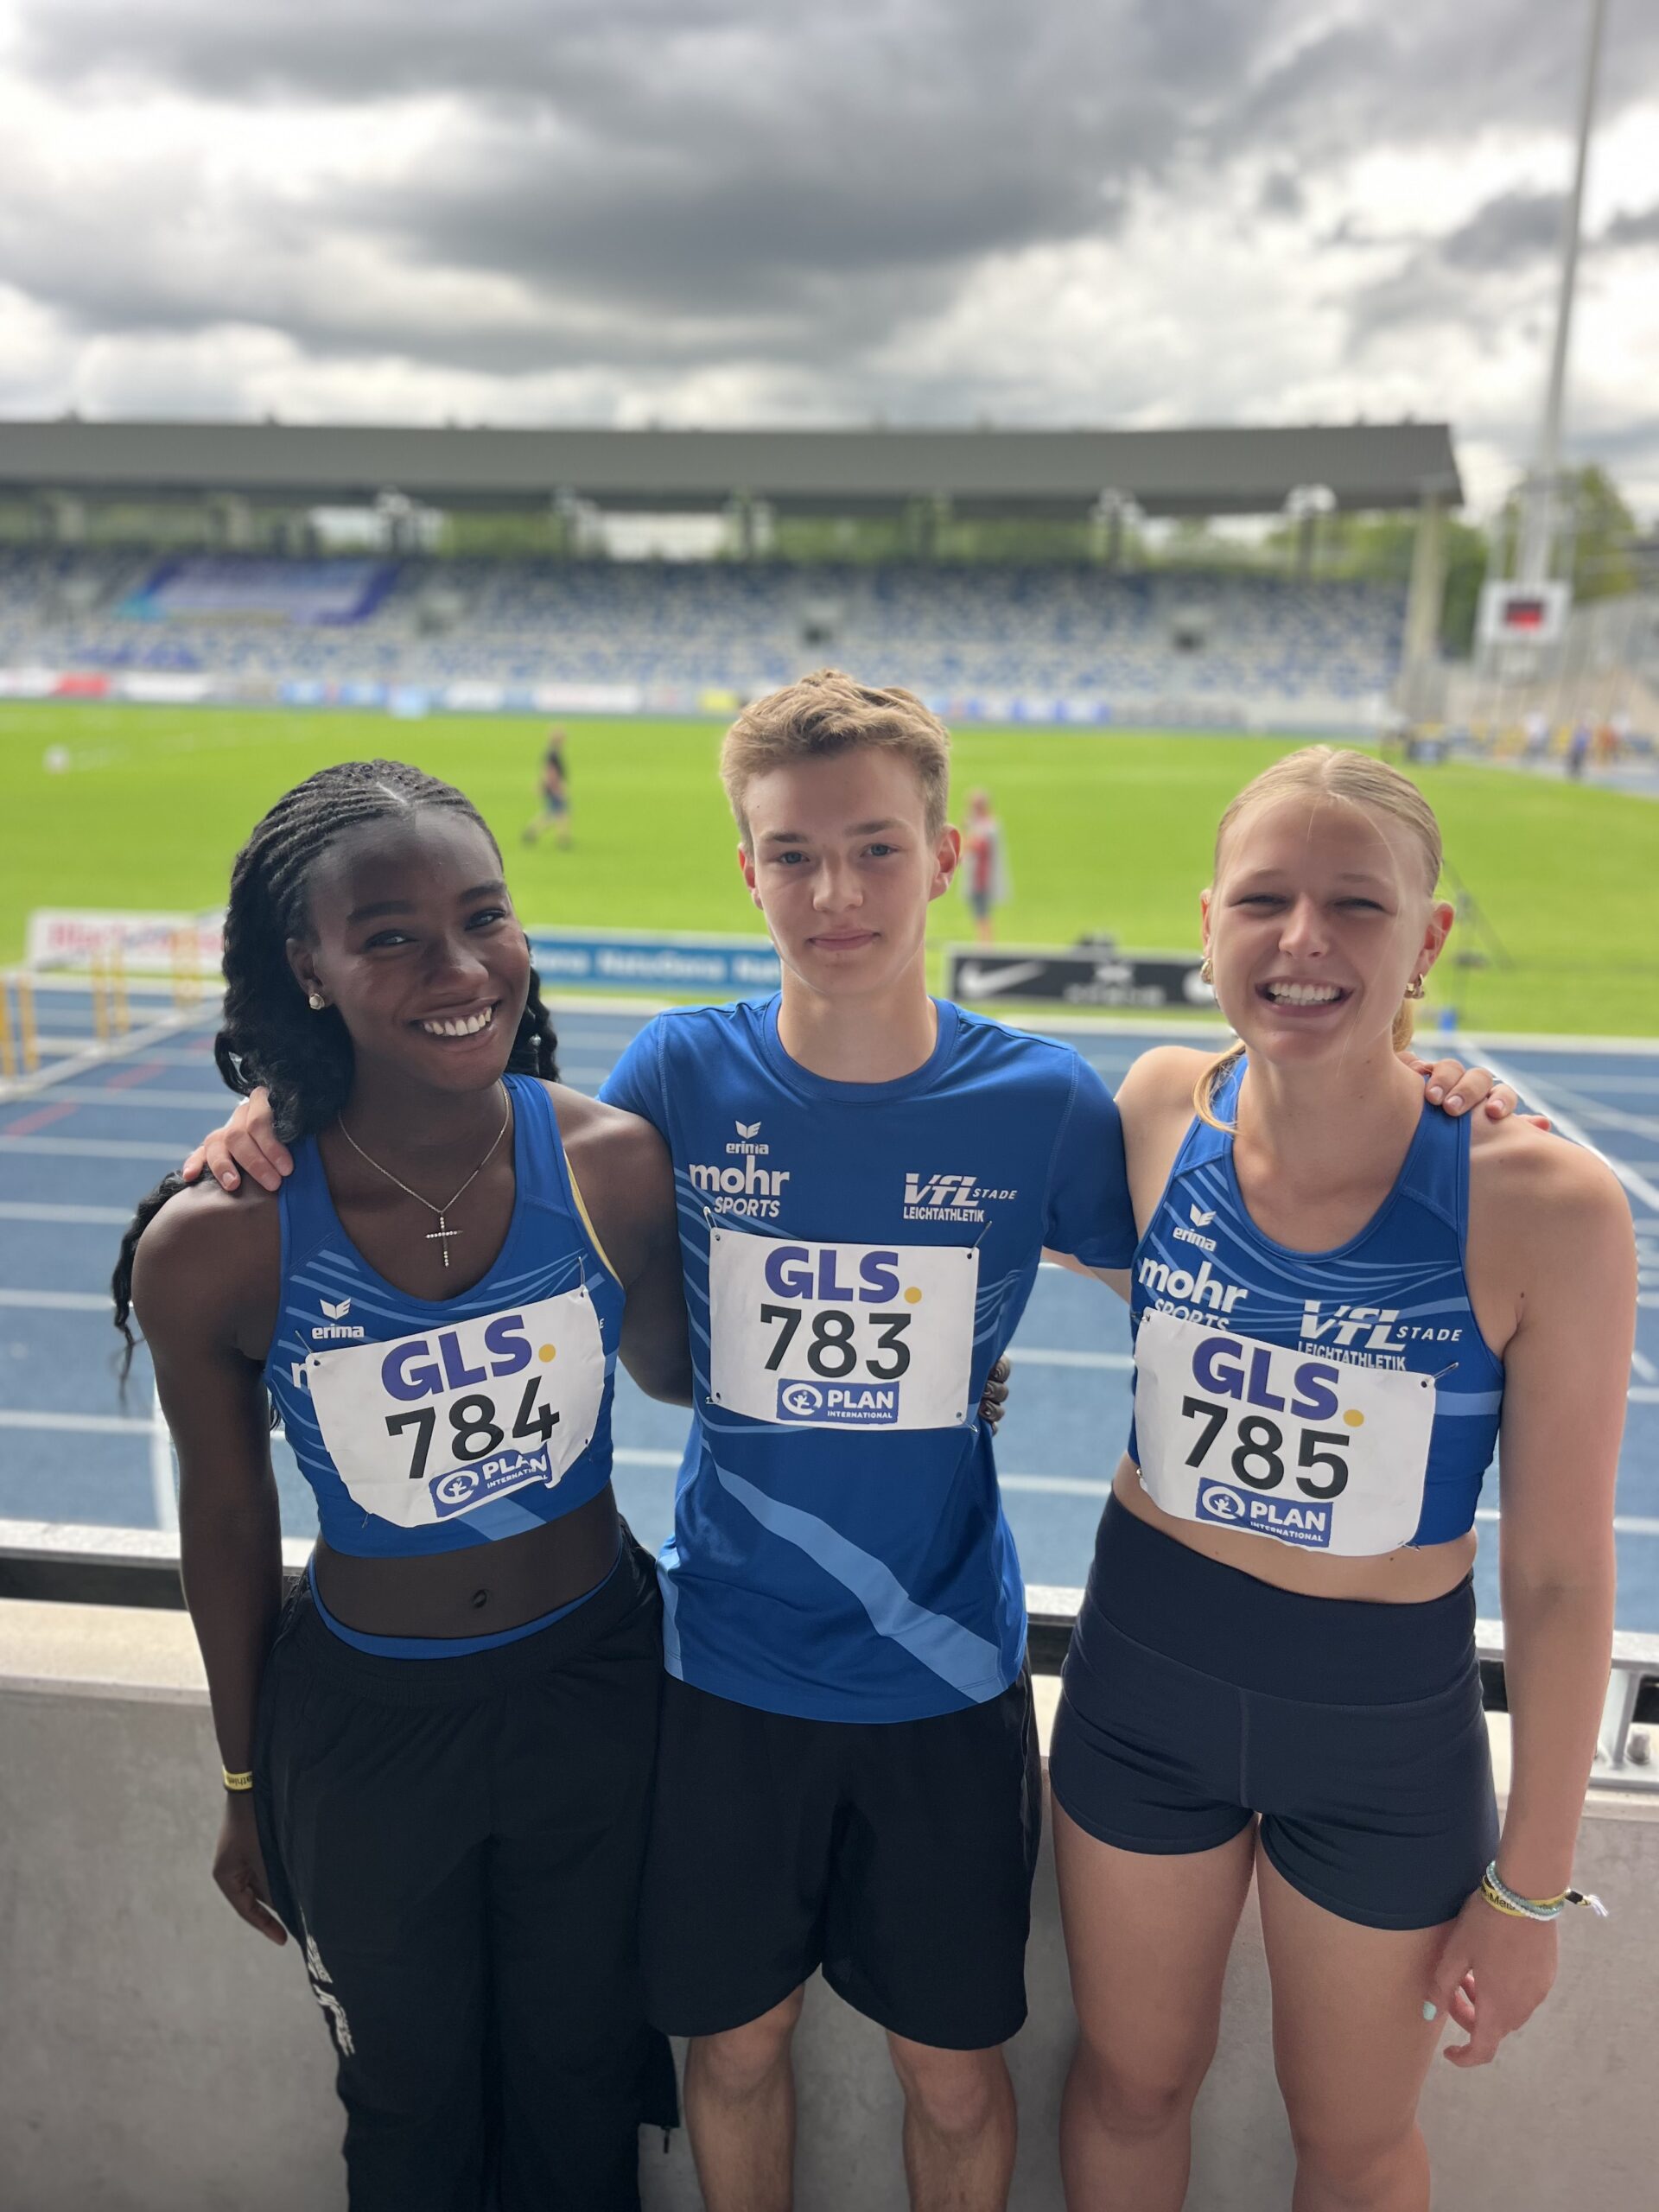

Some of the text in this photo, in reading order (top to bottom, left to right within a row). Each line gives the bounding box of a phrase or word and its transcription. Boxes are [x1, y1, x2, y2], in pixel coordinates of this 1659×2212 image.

[726, 1141, 769, 1154] erima
[689, 1154, 790, 1197] mohr
[904, 1173, 1018, 1207] VfL STADE
[714, 1196, 781, 1217] SPORTS
[903, 1206, 984, 1223] LEICHTATHLETIK
[1173, 1226, 1217, 1252] erima
[1138, 1257, 1249, 1313] mohr
[312, 1323, 365, 1339] erima
[1300, 1299, 1463, 1351] VfL STADE
[760, 1303, 912, 1380] 783
[828, 1389, 894, 1409] PLAN
[385, 1375, 560, 1479] 784
[827, 1410, 893, 1419] INTERNATIONAL
[1181, 1395, 1351, 1500] 785
[482, 1454, 548, 1480] PLAN
[1249, 1500, 1325, 1532] PLAN
[1250, 1521, 1324, 1542] INTERNATIONAL
